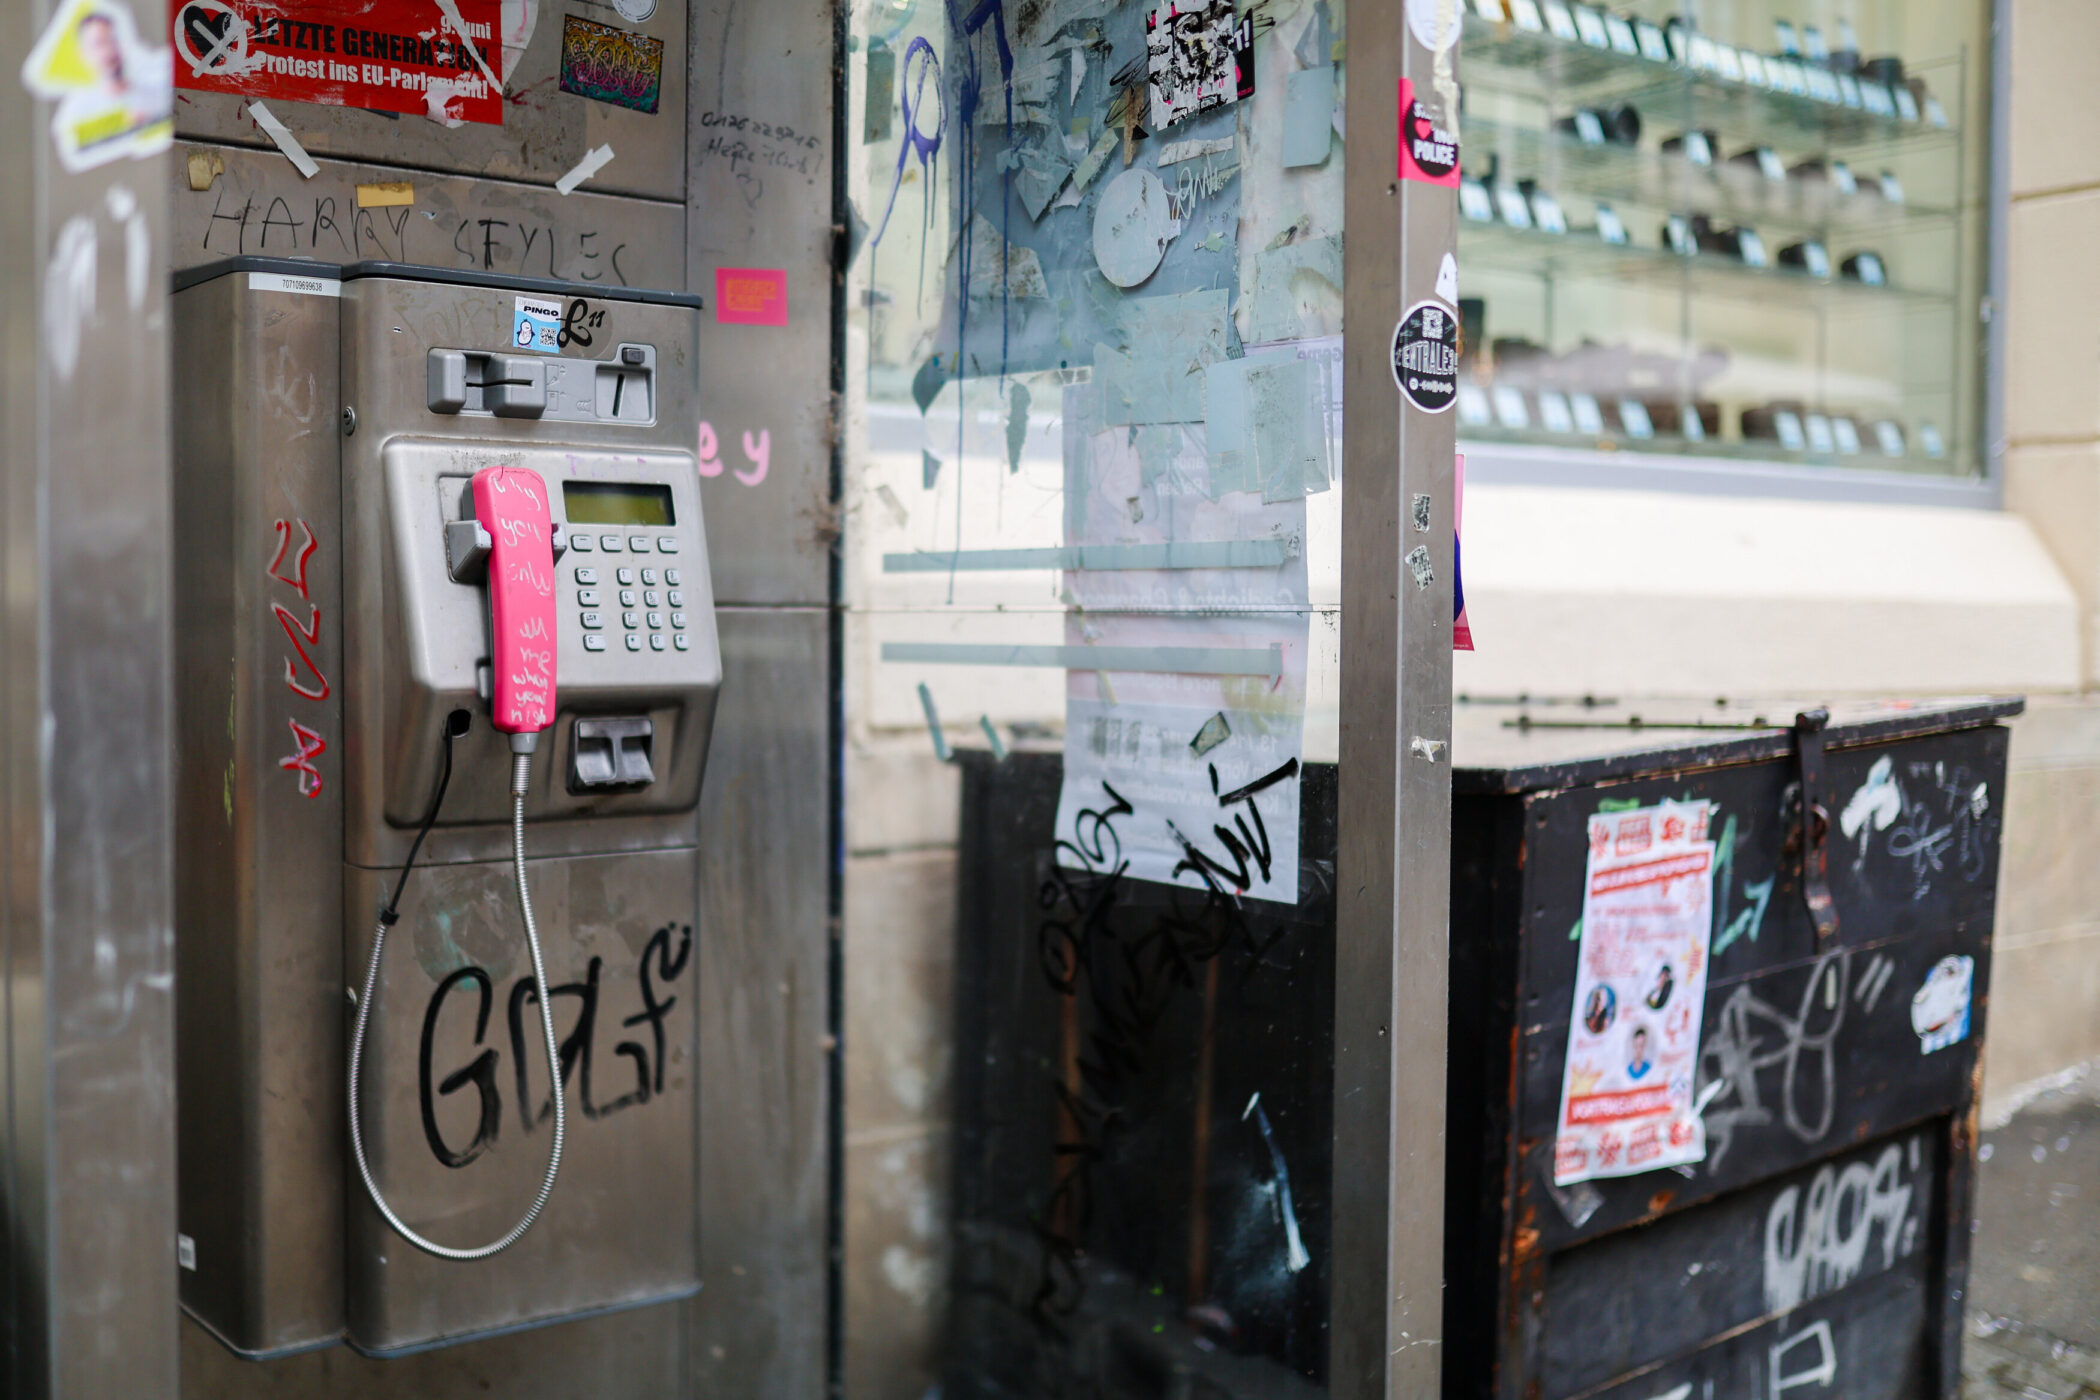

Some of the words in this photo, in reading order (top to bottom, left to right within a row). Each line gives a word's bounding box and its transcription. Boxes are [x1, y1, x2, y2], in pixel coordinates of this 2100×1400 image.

[254, 15, 336, 53] LETZTE
[342, 27, 488, 72] GENERATION
[254, 50, 326, 79] Protest
[329, 60, 358, 83] ins
[1413, 138, 1456, 167] POLICE
[523, 305, 559, 317] PINGO
